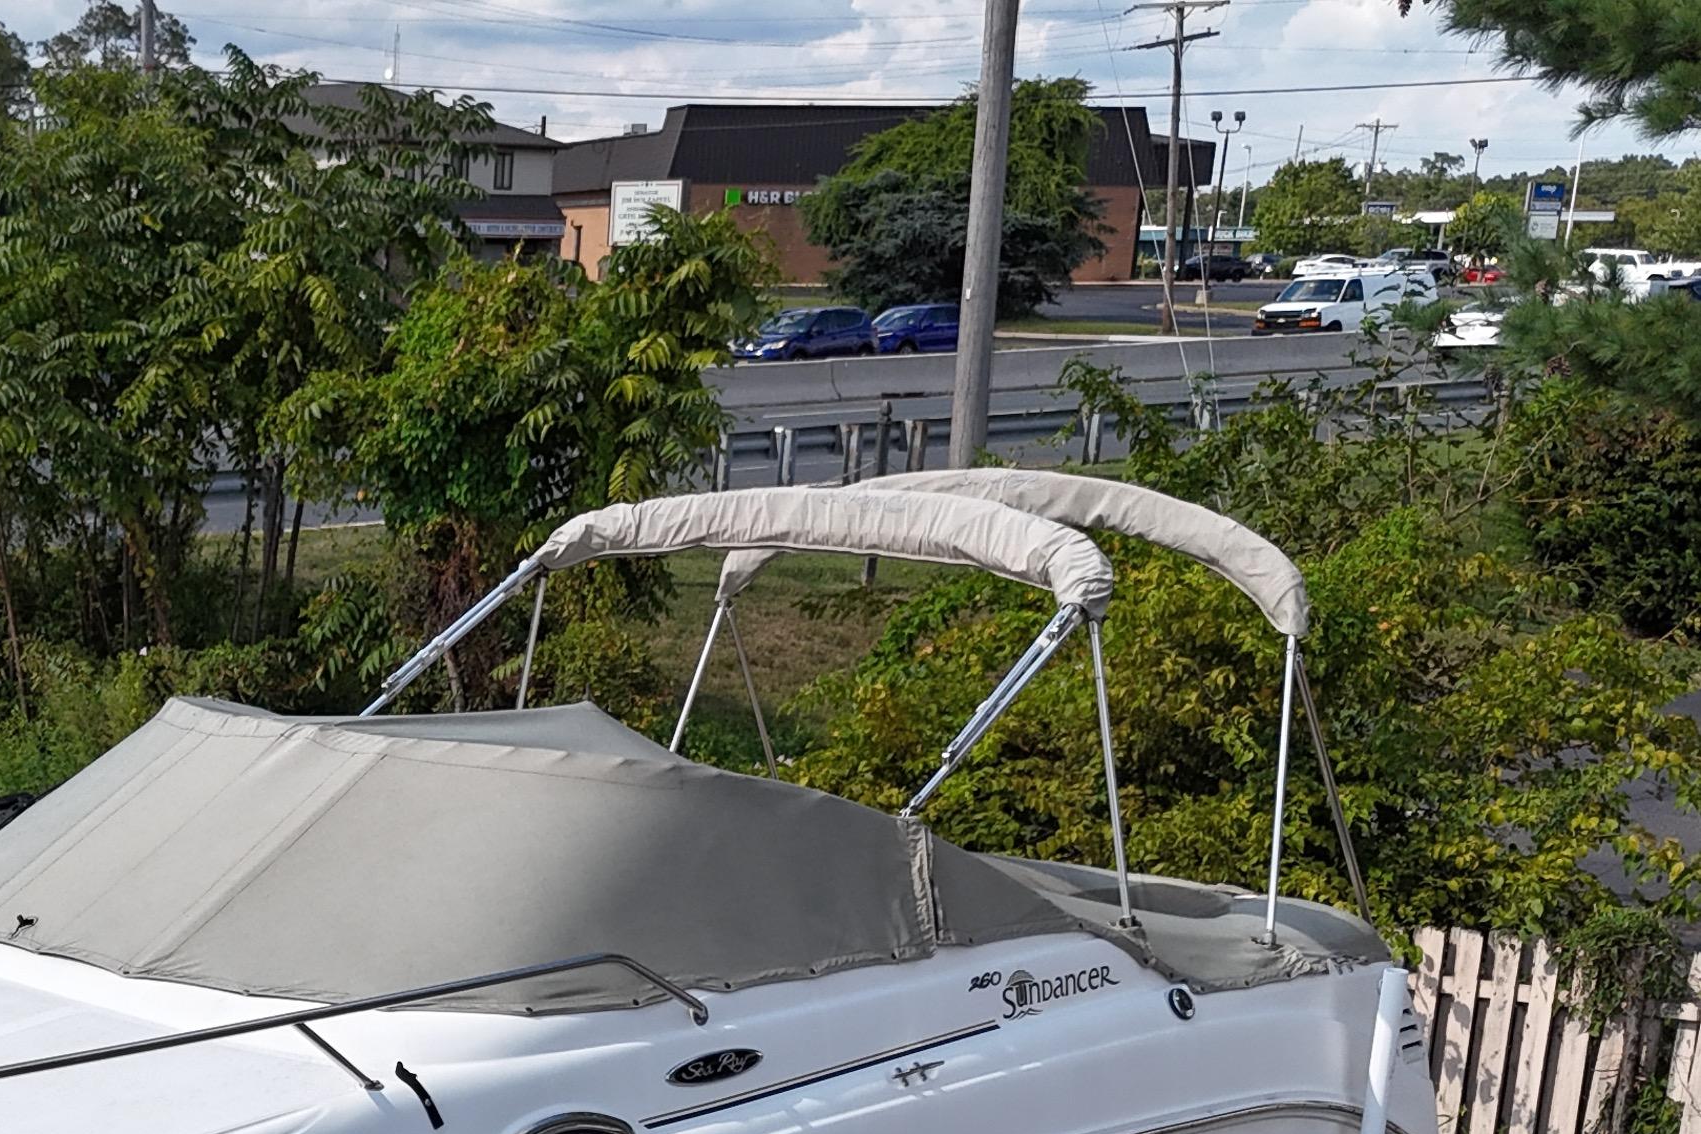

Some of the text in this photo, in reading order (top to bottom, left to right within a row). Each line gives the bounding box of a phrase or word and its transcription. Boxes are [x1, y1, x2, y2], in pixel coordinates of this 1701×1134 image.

[748, 191, 780, 204] H&R
[968, 970, 1002, 992] 260
[681, 1052, 756, 1080] Sea Ray
